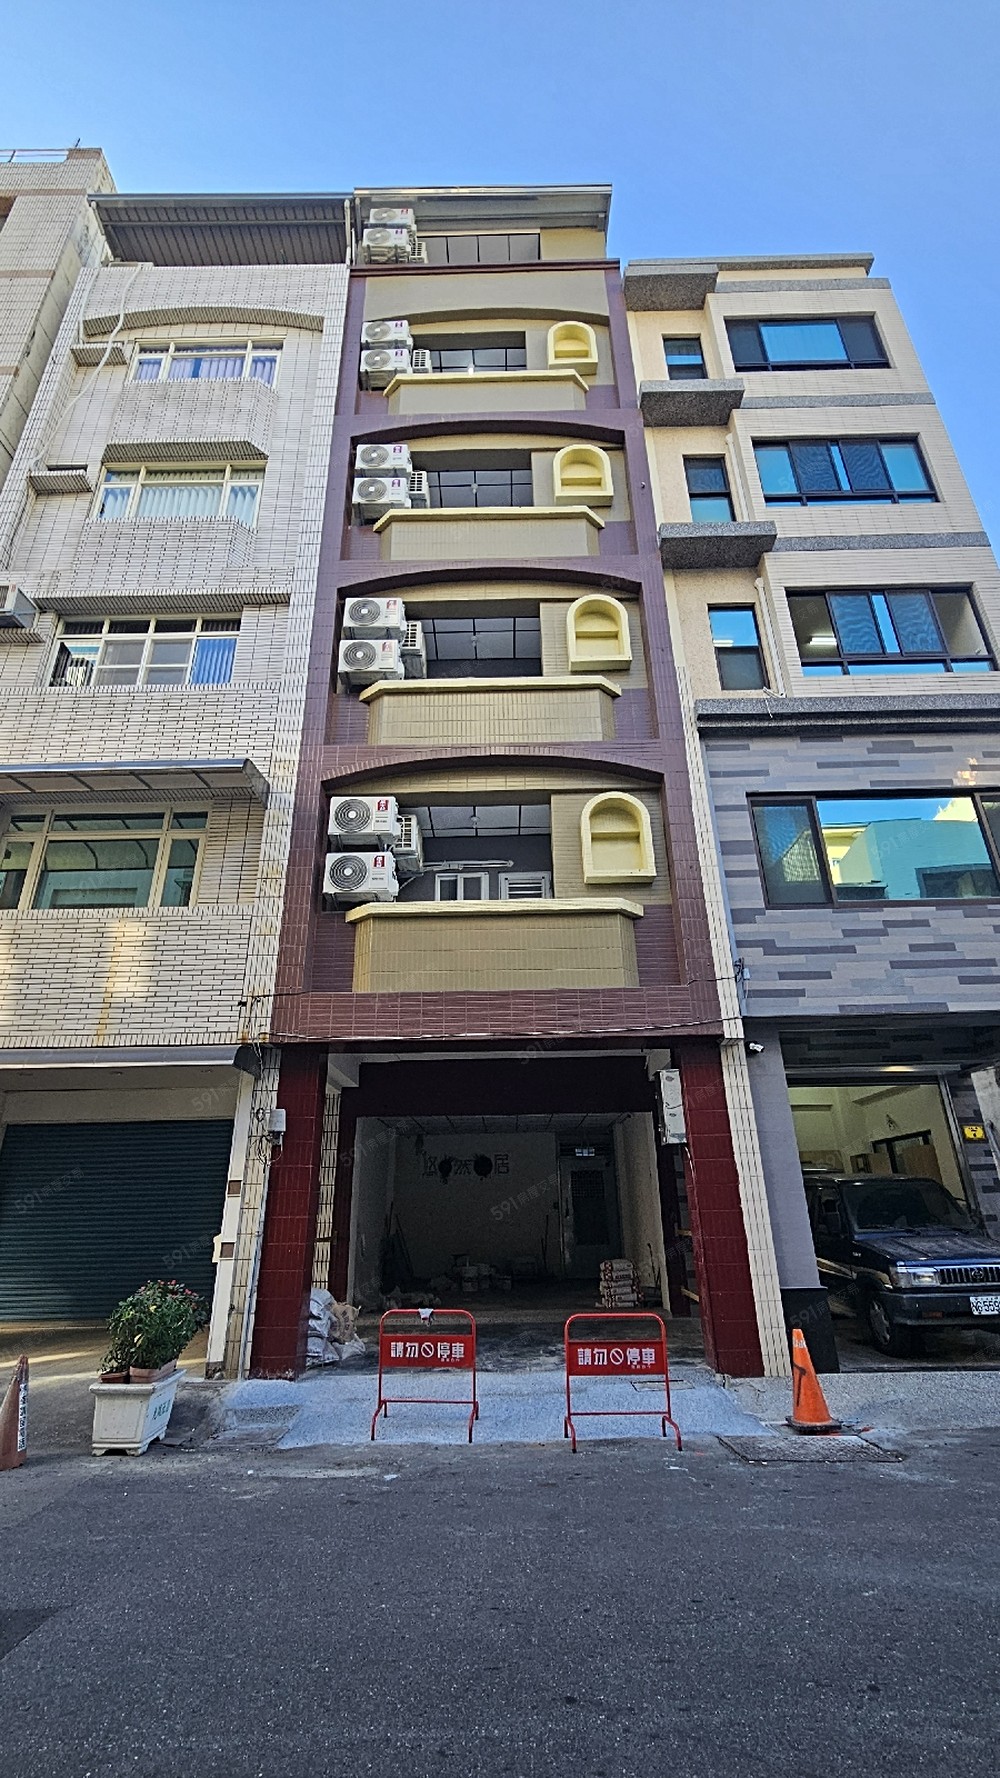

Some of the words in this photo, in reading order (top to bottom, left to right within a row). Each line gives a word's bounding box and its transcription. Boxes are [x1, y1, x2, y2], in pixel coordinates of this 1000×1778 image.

[390, 1341, 419, 1358] 請勿
[437, 1341, 465, 1359] 停車
[577, 1347, 608, 1366] 請勿
[626, 1347, 656, 1366] 停車
